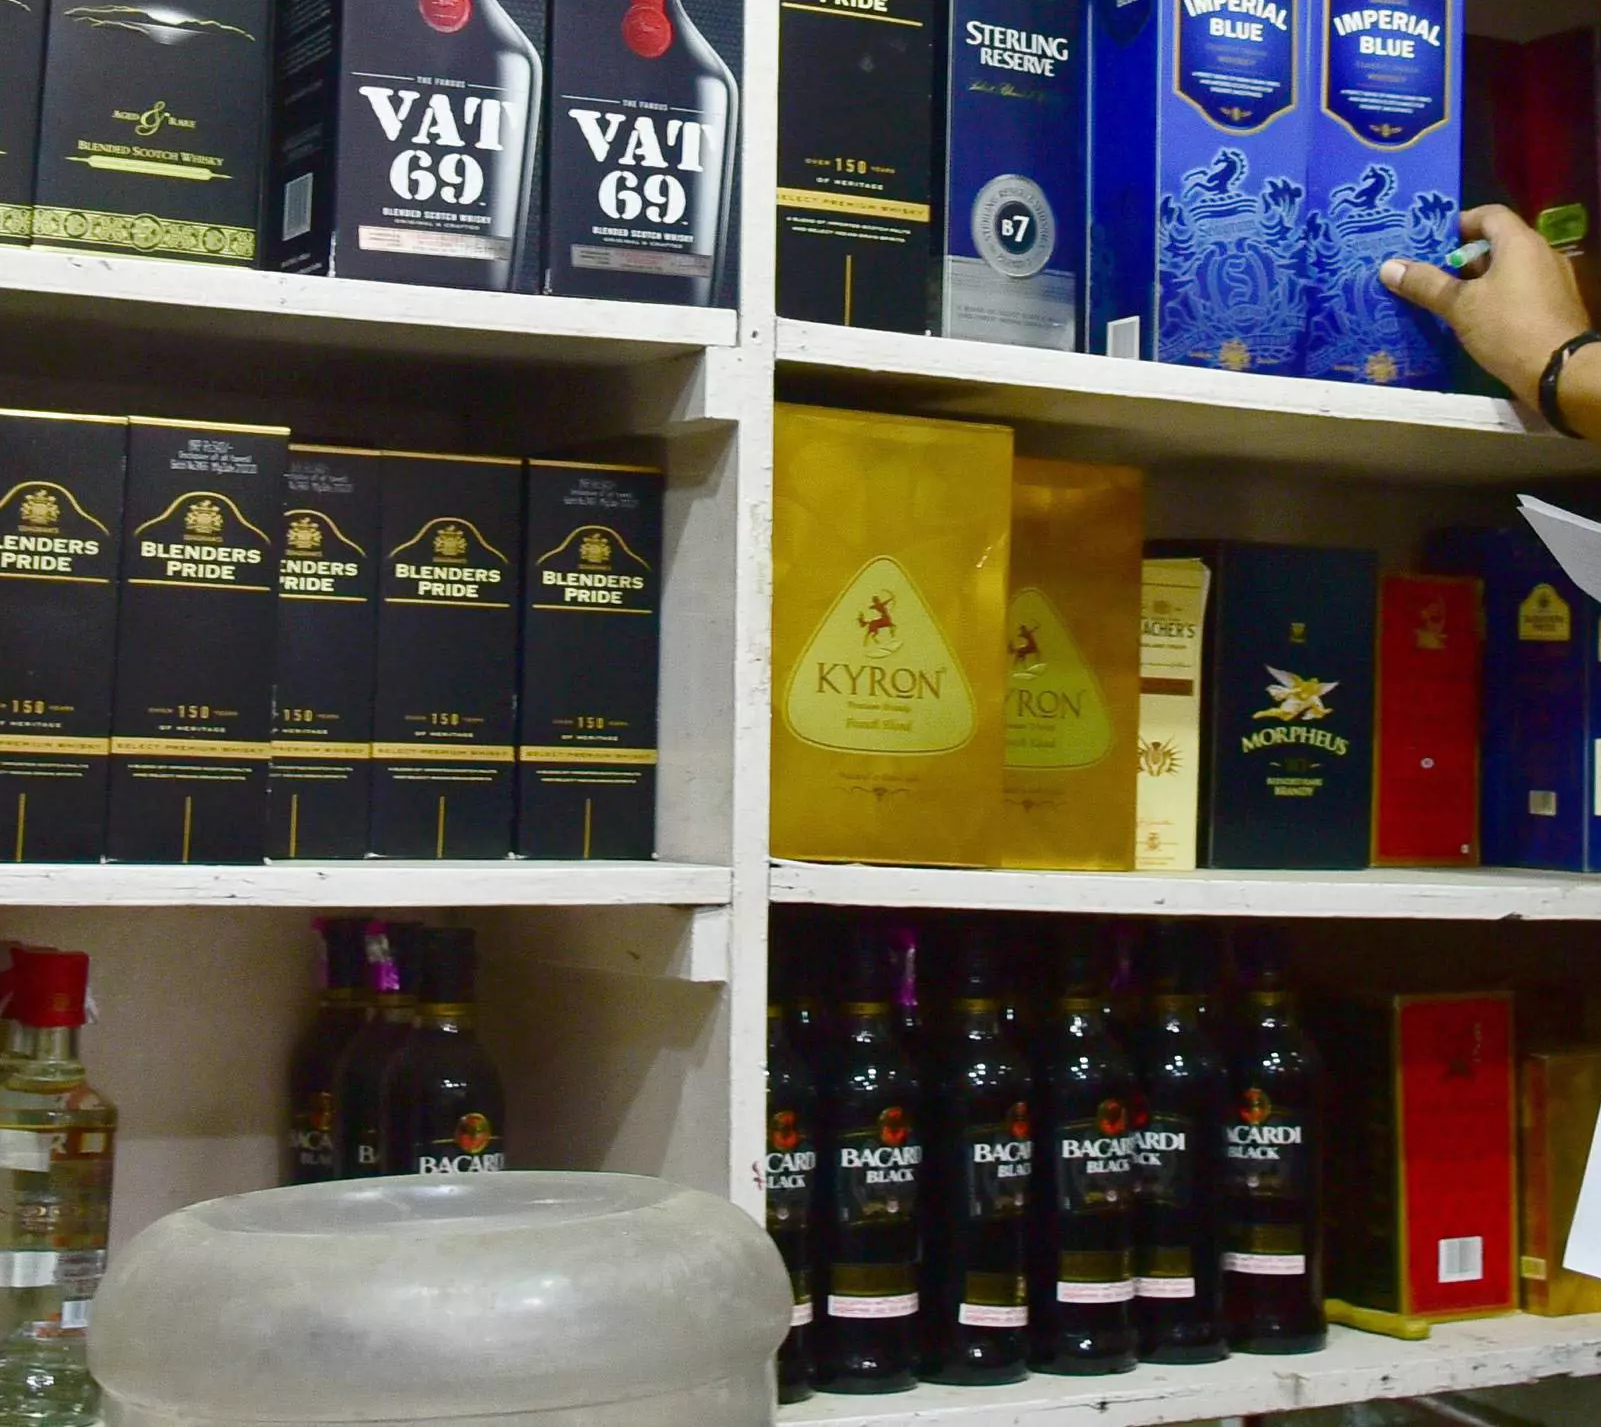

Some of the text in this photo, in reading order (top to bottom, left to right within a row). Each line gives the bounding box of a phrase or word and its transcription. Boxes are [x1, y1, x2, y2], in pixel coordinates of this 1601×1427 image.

[1210, 17, 1264, 42] BLUE
[1334, 9, 1441, 47] IMPERIAL
[966, 19, 1069, 62] STERLING
[1359, 35, 1415, 59] BLUE
[979, 46, 1056, 77] RESERVE
[434, 78, 466, 89] FAMOUS
[638, 102, 668, 112] FAMOUS
[359, 85, 518, 151] VAT
[569, 108, 713, 173] VAT
[77, 139, 225, 167] BLENDED SCOTCH WHISKY
[834, 157, 868, 175] 150
[389, 149, 483, 205] 69
[599, 171, 687, 224] 69
[382, 206, 492, 226] BLENDED SCOTCH WHISKY
[592, 226, 694, 244] BLENDED SCOTCH WHISKY
[1002, 215, 1030, 242] B7
[0, 552, 72, 573] PRIDE
[141, 540, 261, 564] BLENDERS
[166, 560, 236, 581] PRIDE
[396, 563, 501, 584] BLENDERS
[542, 570, 644, 590] BLENDERS
[418, 581, 479, 599] PRIDE
[564, 587, 623, 604] PRIDE
[816, 663, 941, 701] KYRON
[12, 699, 45, 715] 150
[177, 705, 209, 719] 150
[283, 709, 313, 722] 150
[431, 712, 460, 725] 150
[577, 716, 605, 729] 150
[1241, 726, 1349, 755] MORPHEUS
[866, 1169, 914, 1184] BLACK
